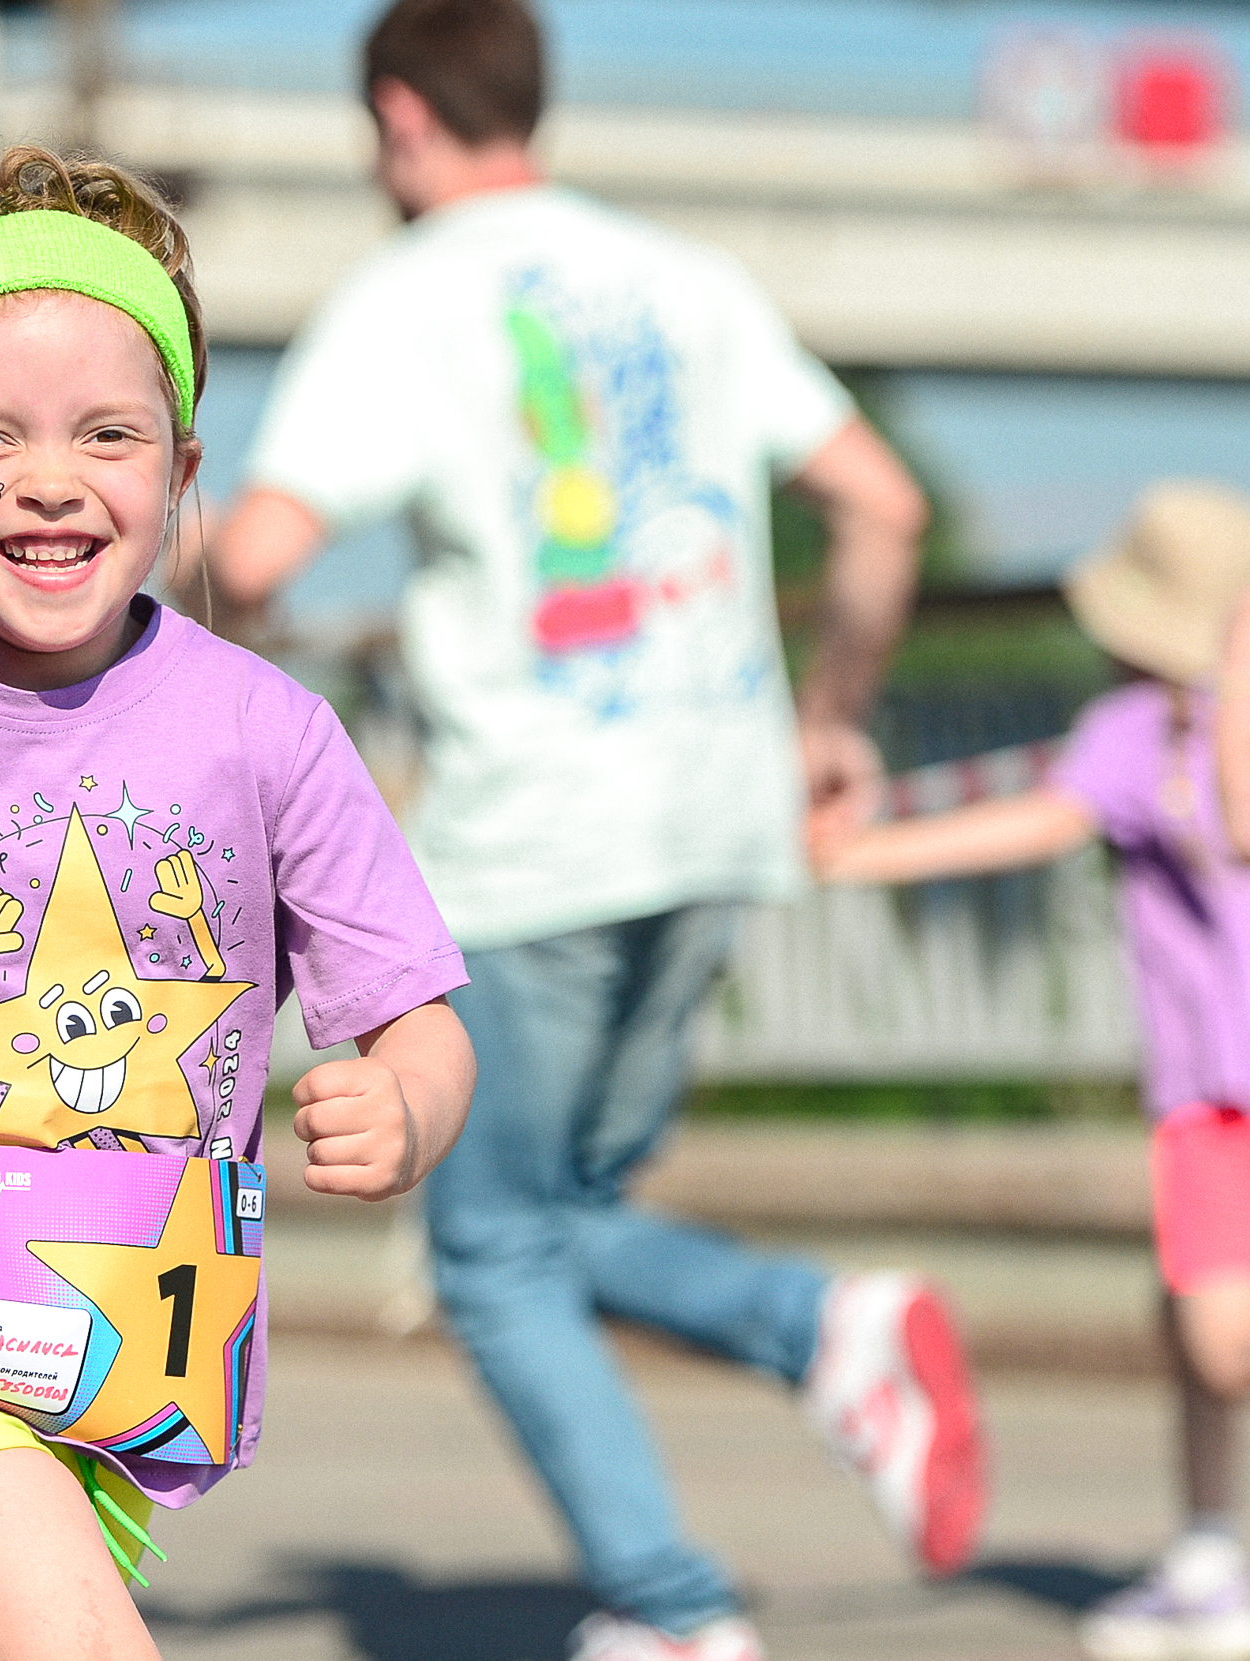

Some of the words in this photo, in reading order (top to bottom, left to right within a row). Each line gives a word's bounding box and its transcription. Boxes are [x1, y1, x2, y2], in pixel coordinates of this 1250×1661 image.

[216, 1029, 242, 1122] 2024
[5, 1171, 31, 1186] KIDS
[157, 1264, 197, 1378] 1
[11, 1369, 58, 1381] родителей
